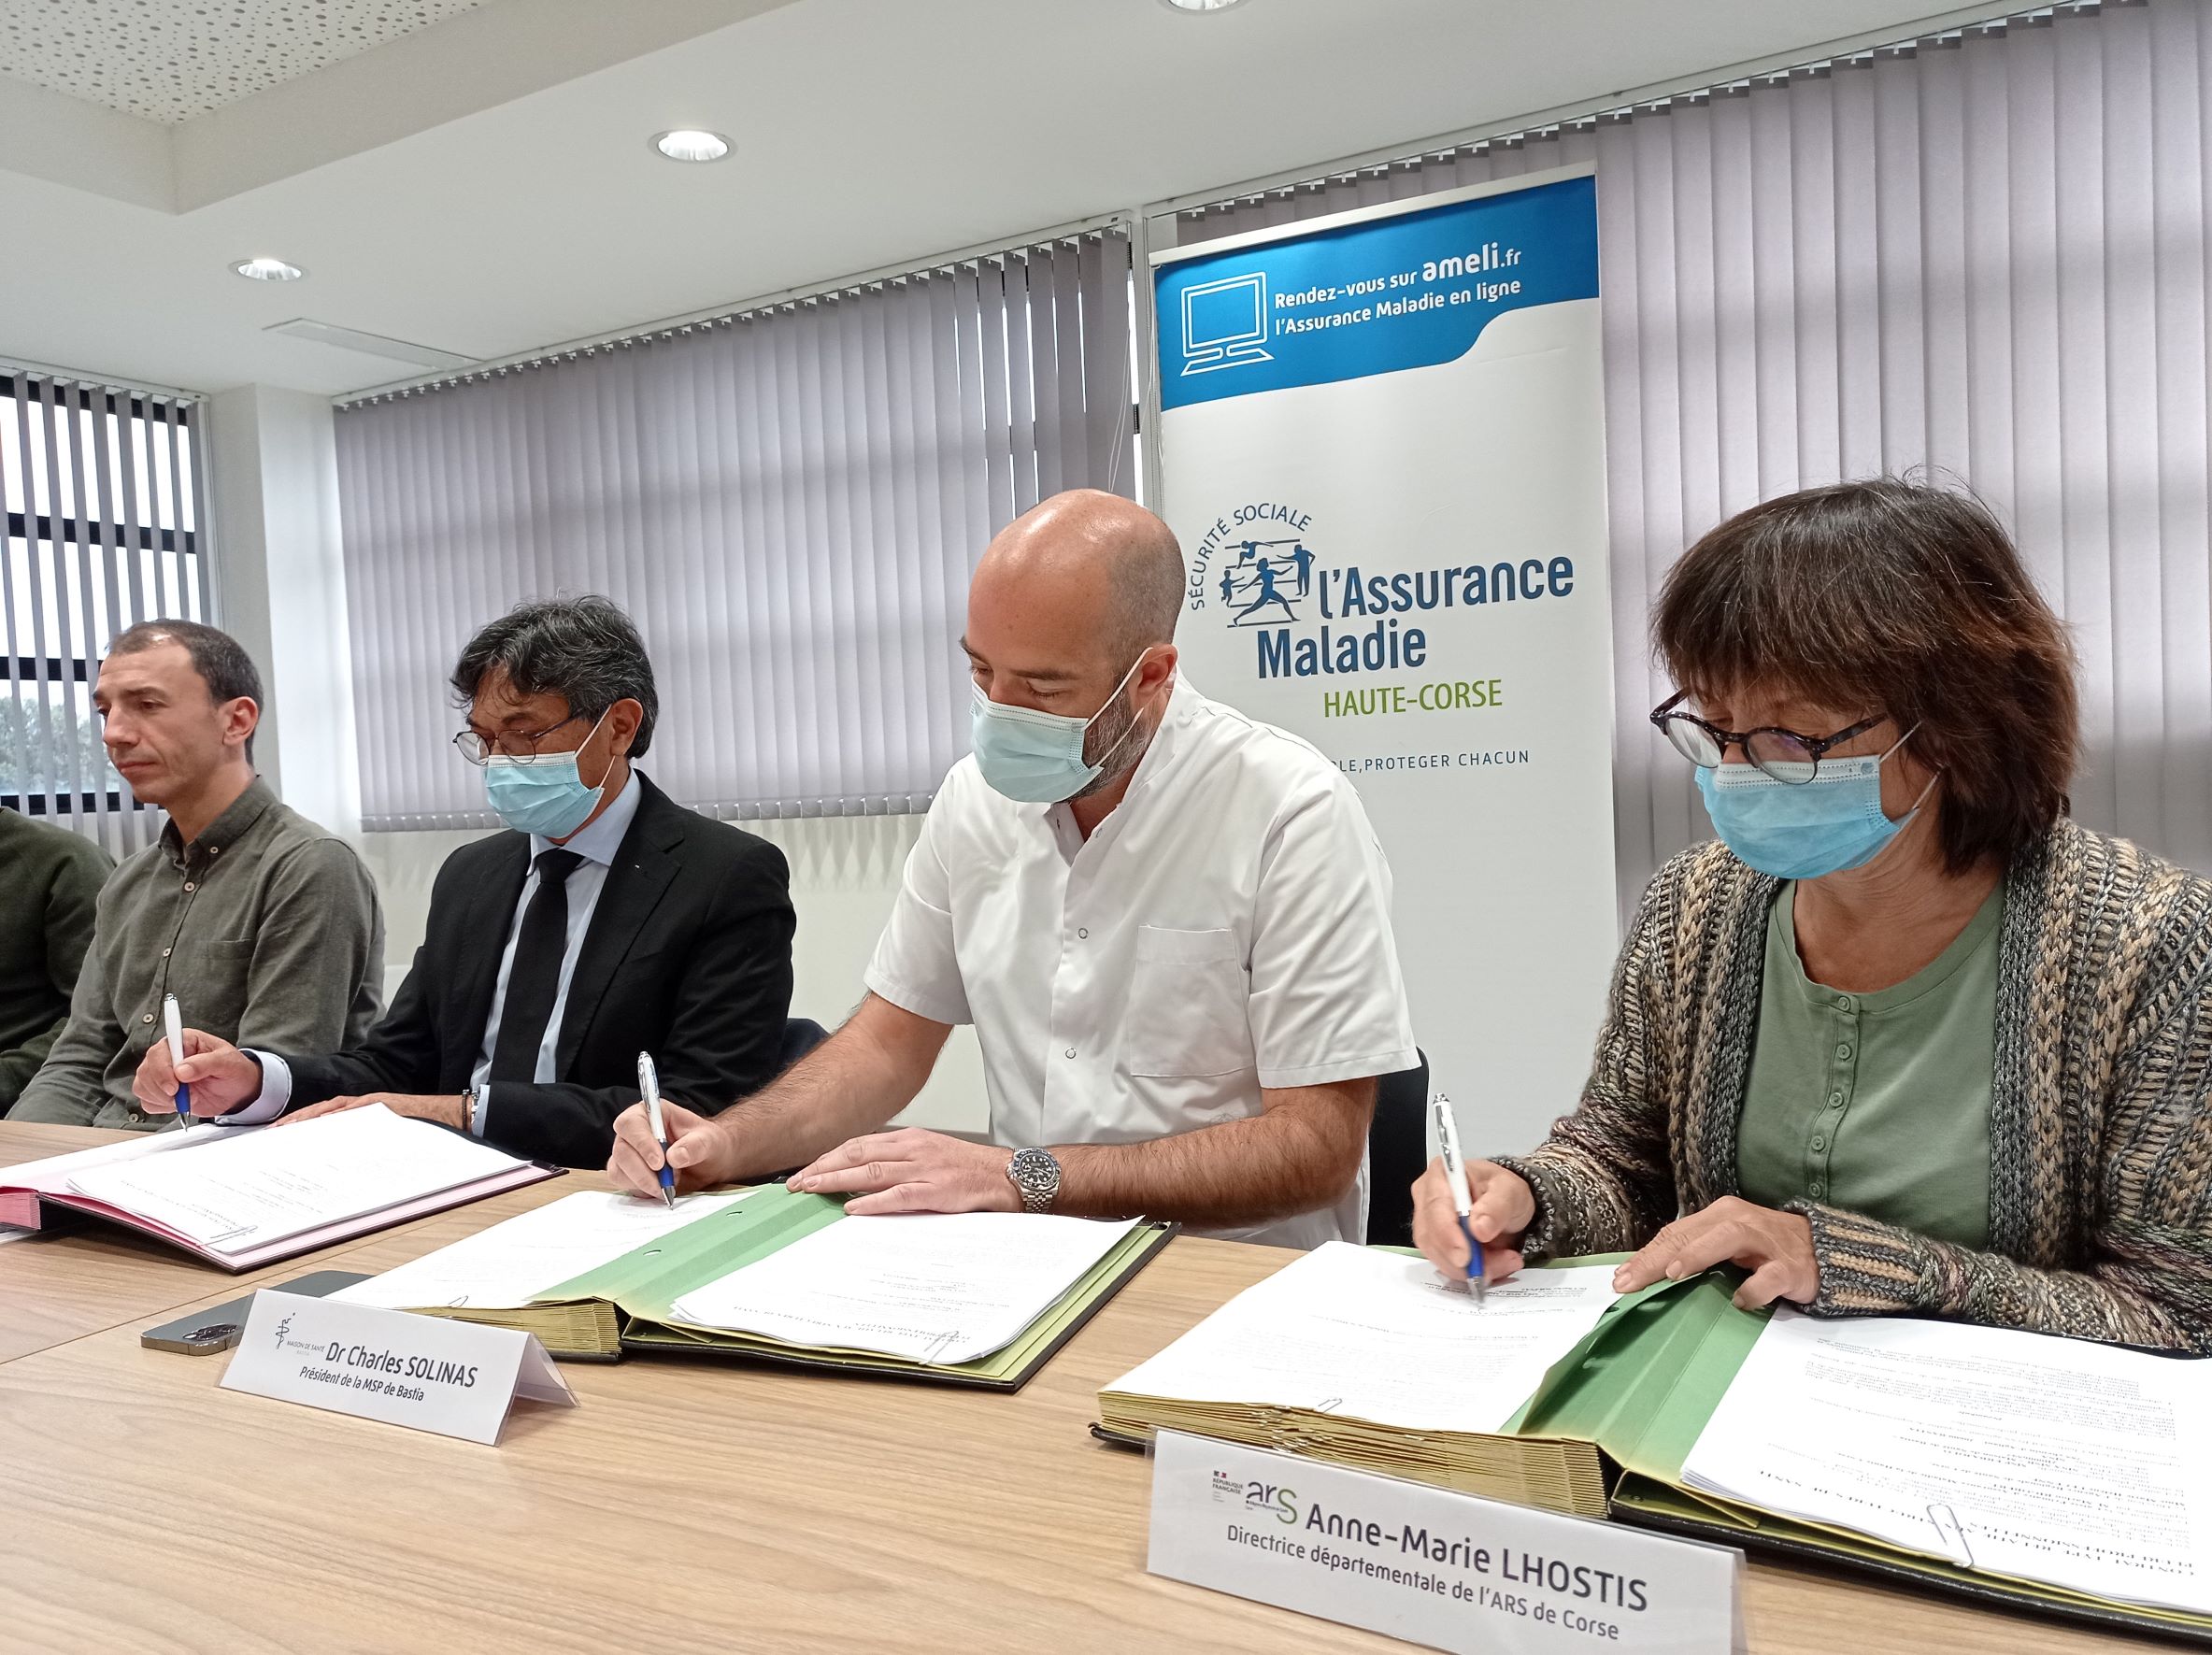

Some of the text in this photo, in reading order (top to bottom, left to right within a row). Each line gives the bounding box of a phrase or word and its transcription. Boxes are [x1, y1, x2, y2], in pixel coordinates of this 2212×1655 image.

[1274, 277, 1386, 309] Rendez-vous
[1390, 270, 1418, 289] sur
[1275, 279, 1521, 335] l'Assurance Maladie en ligne
[1187, 502, 1312, 611] SÉCURITÉ SOCIALE
[1319, 555, 1574, 620] l'Assurance
[1257, 618, 1427, 679] Maladie
[1323, 678, 1503, 718] HAUTE-CORSE
[1458, 749, 1530, 766] CHACUN
[299, 1366, 424, 1402] Président de la MSP de Bastia
[325, 1341, 478, 1388] Dr Charles SOLINAS
[1227, 1524, 1619, 1640] Directrice départementale de l'ARS de Corse
[1306, 1503, 1648, 1612] Anne-Marie LHOSTIS
